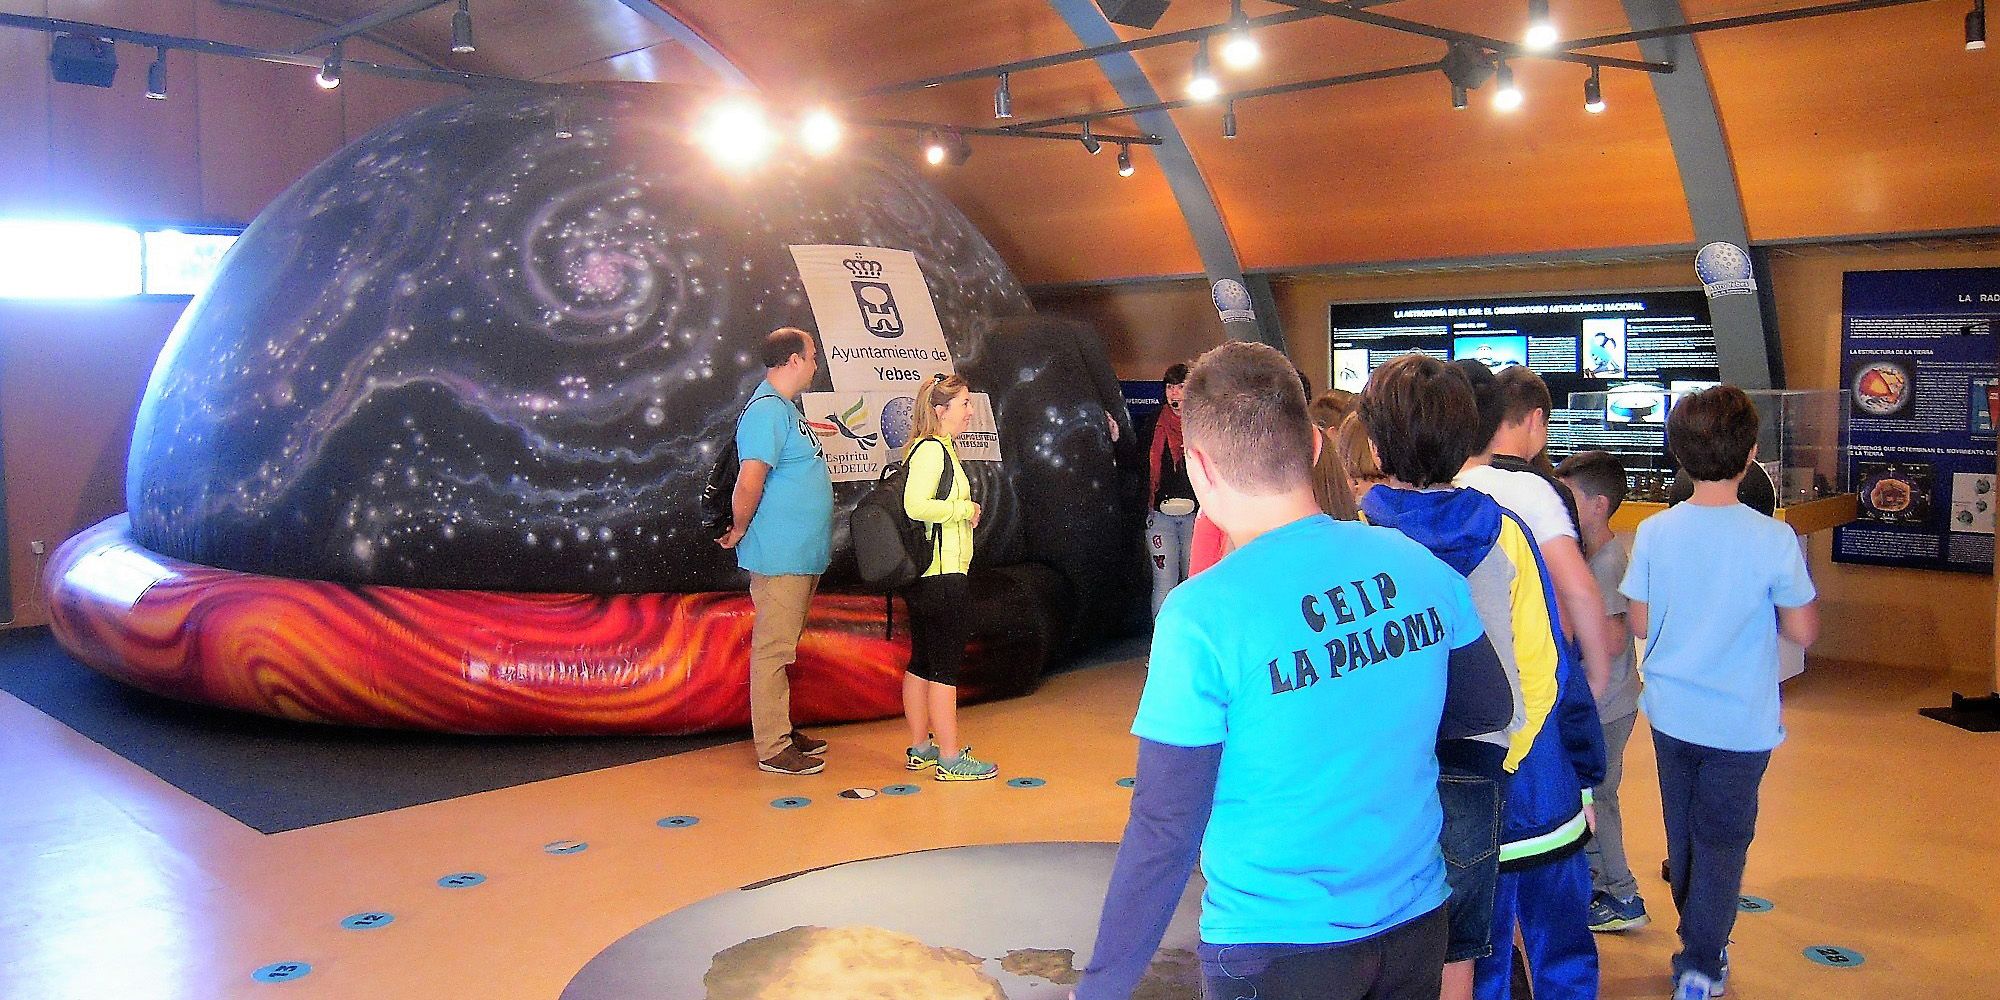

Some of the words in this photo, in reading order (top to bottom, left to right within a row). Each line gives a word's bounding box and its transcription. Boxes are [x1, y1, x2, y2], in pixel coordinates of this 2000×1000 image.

[1959, 294, 1971, 302] LA
[831, 344, 929, 364] Ayuntamiento
[931, 347, 949, 362] de
[873, 365, 921, 381] Yebes
[824, 451, 869, 464] Espíritu
[1301, 572, 1397, 633] CEIP
[1267, 648, 1320, 695] LA
[1324, 606, 1446, 679] PALOMA
[353, 914, 385, 925] 12
[1815, 948, 1851, 963] 28
[268, 965, 299, 978] 13
